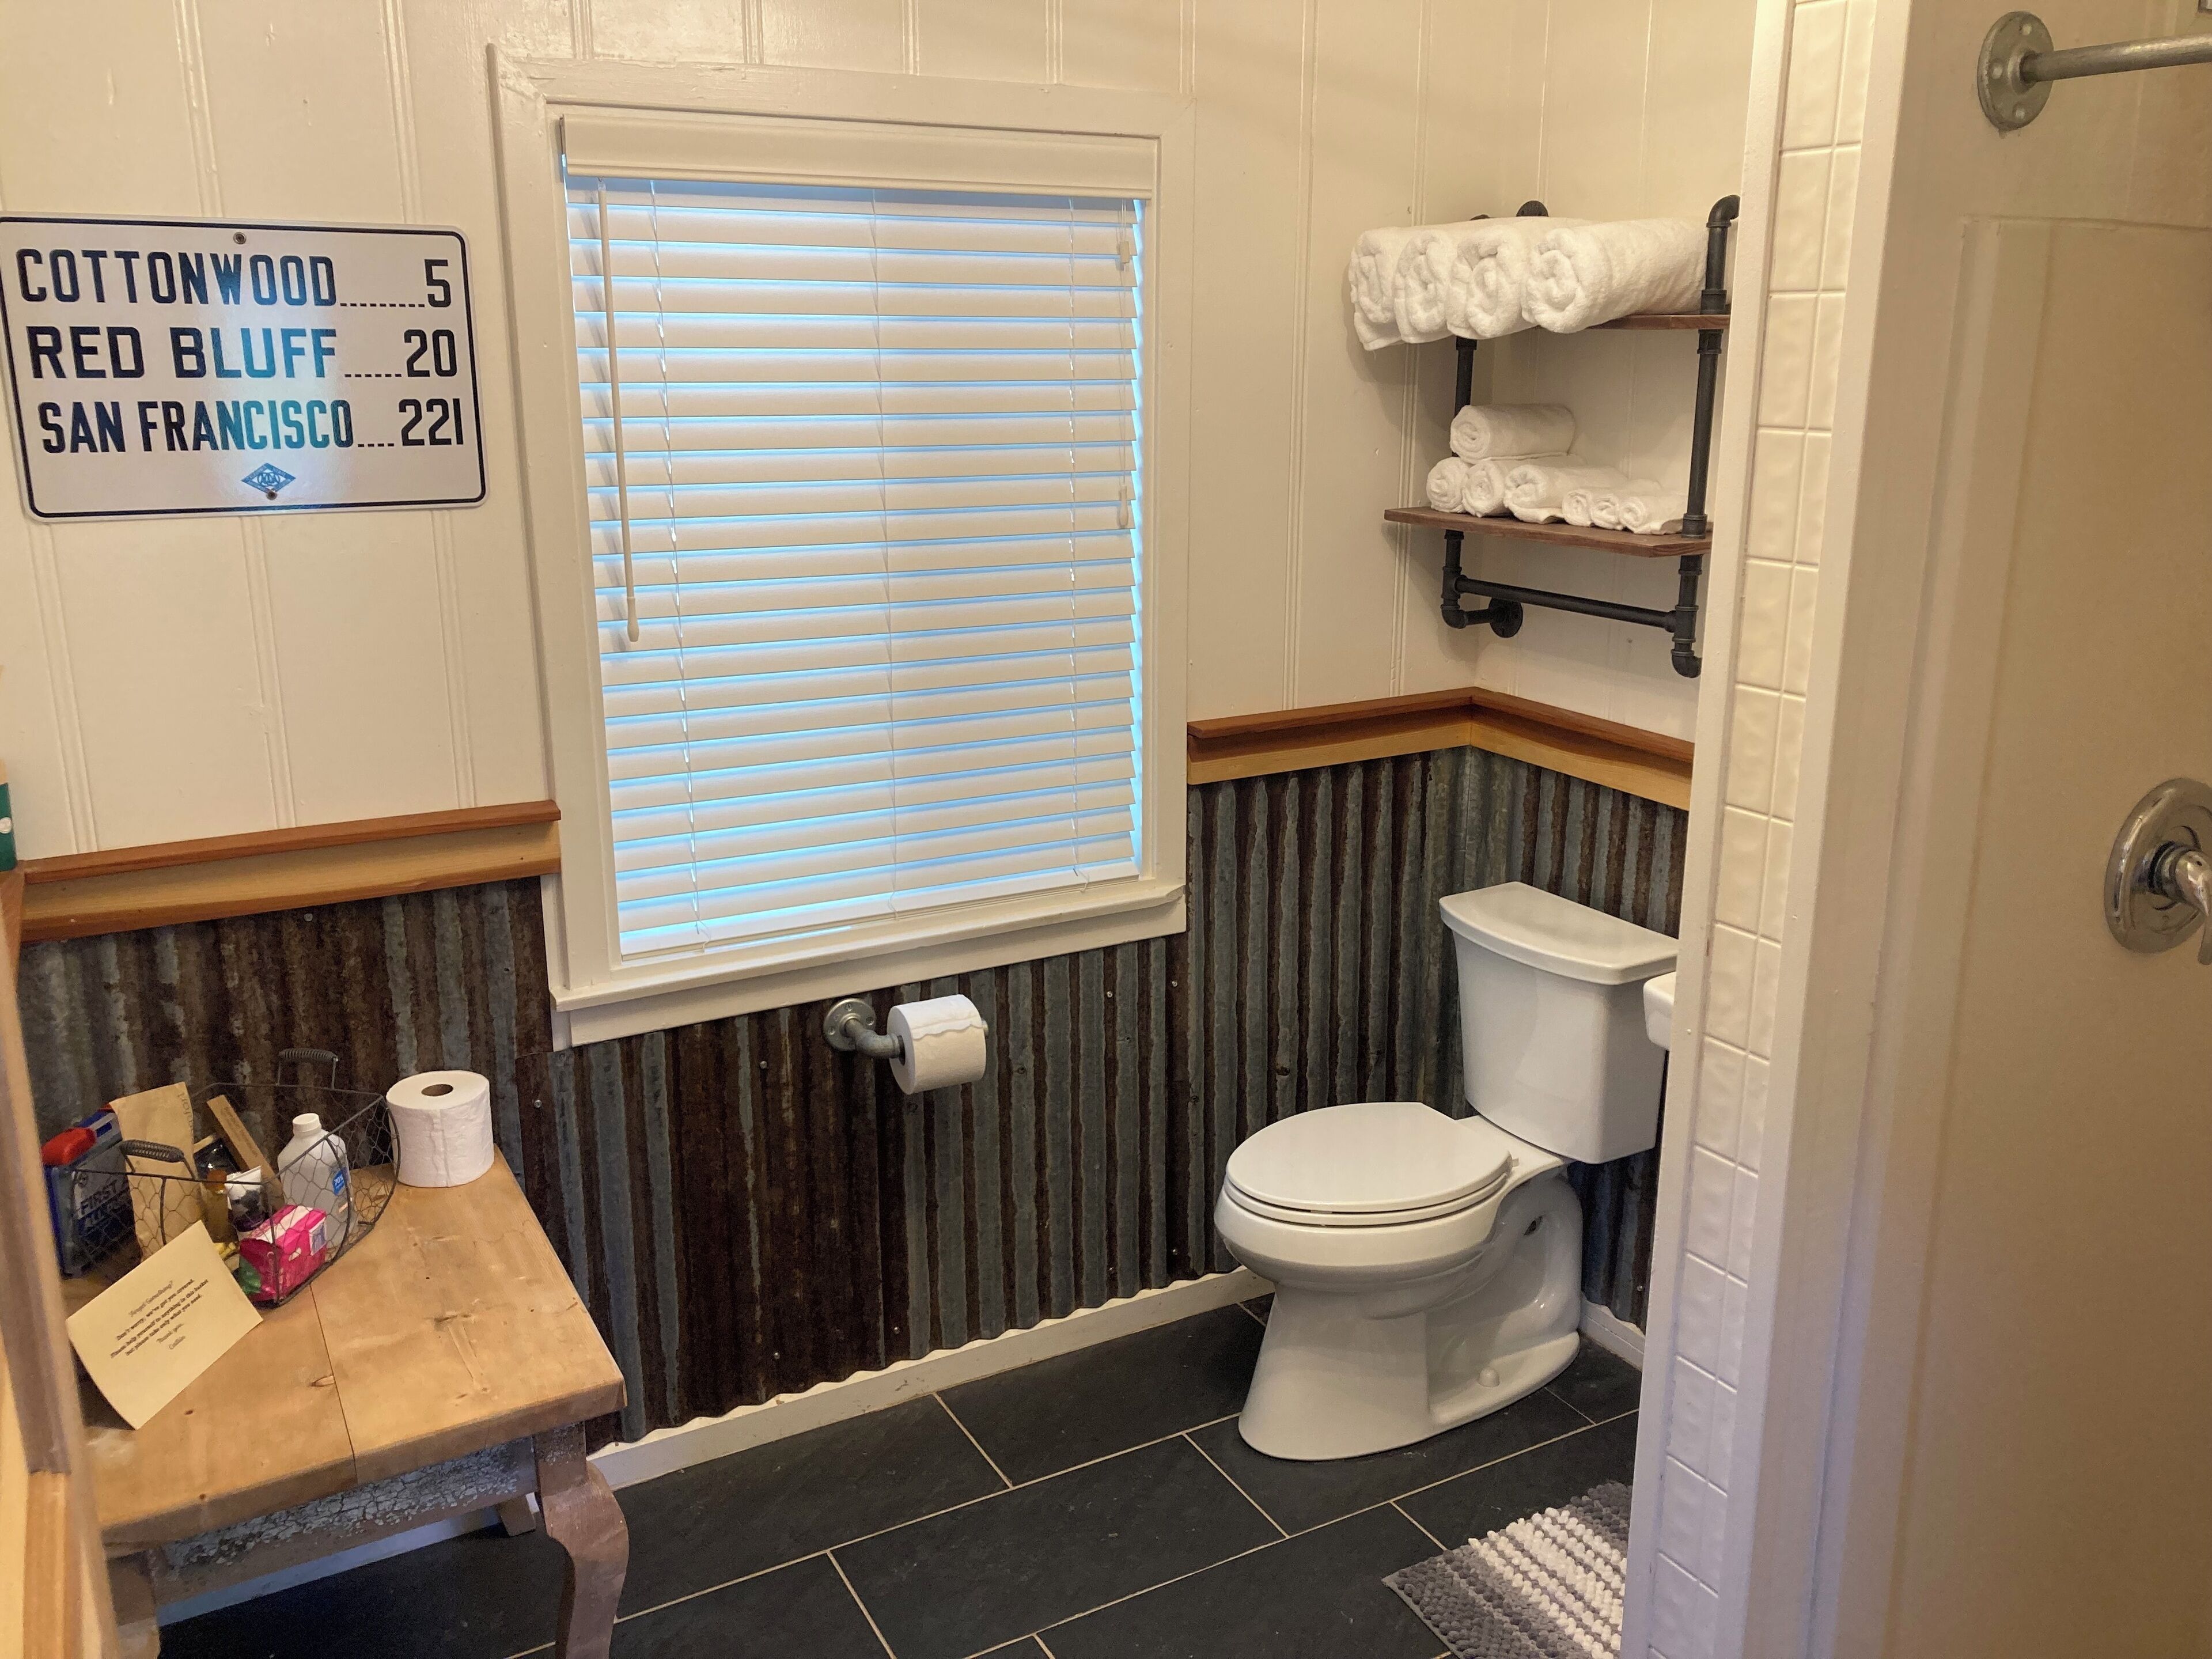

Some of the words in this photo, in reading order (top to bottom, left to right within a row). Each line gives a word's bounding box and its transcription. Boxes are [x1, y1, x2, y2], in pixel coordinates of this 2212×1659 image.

[16, 248, 337, 306] COTTONWOOD
[425, 259, 452, 308] 5
[26, 326, 145, 379] RED
[170, 327, 337, 378] BLUFF
[404, 329, 457, 378] 20
[38, 401, 126, 454] SAN
[138, 399, 354, 453] FRANCISCO
[398, 398, 464, 446] 221
[79, 1179, 118, 1217] FIRST
[126, 1336, 137, 1346] help
[161, 1302, 181, 1318] anything
[186, 1290, 195, 1298] this
[160, 1319, 171, 1328] only
[170, 1309, 182, 1320] what
[181, 1302, 191, 1312] you
[168, 1293, 177, 1302] you
